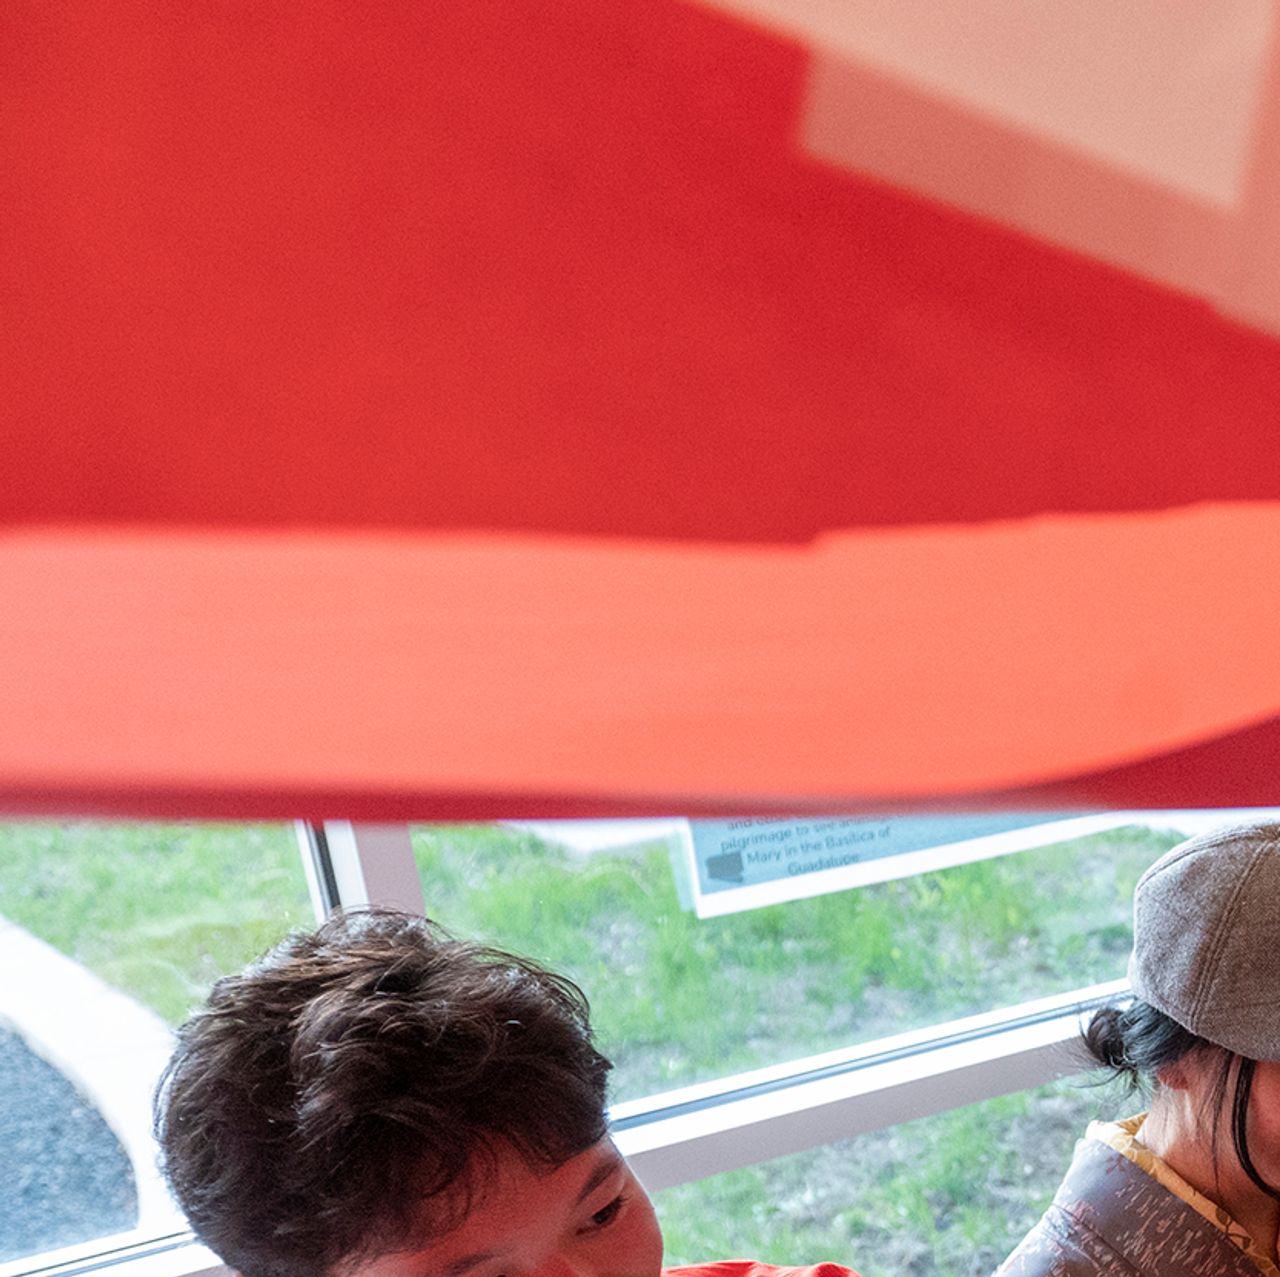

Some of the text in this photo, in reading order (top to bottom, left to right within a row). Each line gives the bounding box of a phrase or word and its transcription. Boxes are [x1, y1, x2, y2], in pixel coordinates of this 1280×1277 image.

[720, 828, 793, 853] pilgrimage
[795, 825, 809, 837] to
[746, 825, 891, 865] Mary in the Basilica of
[786, 851, 861, 876] Guadalupe
